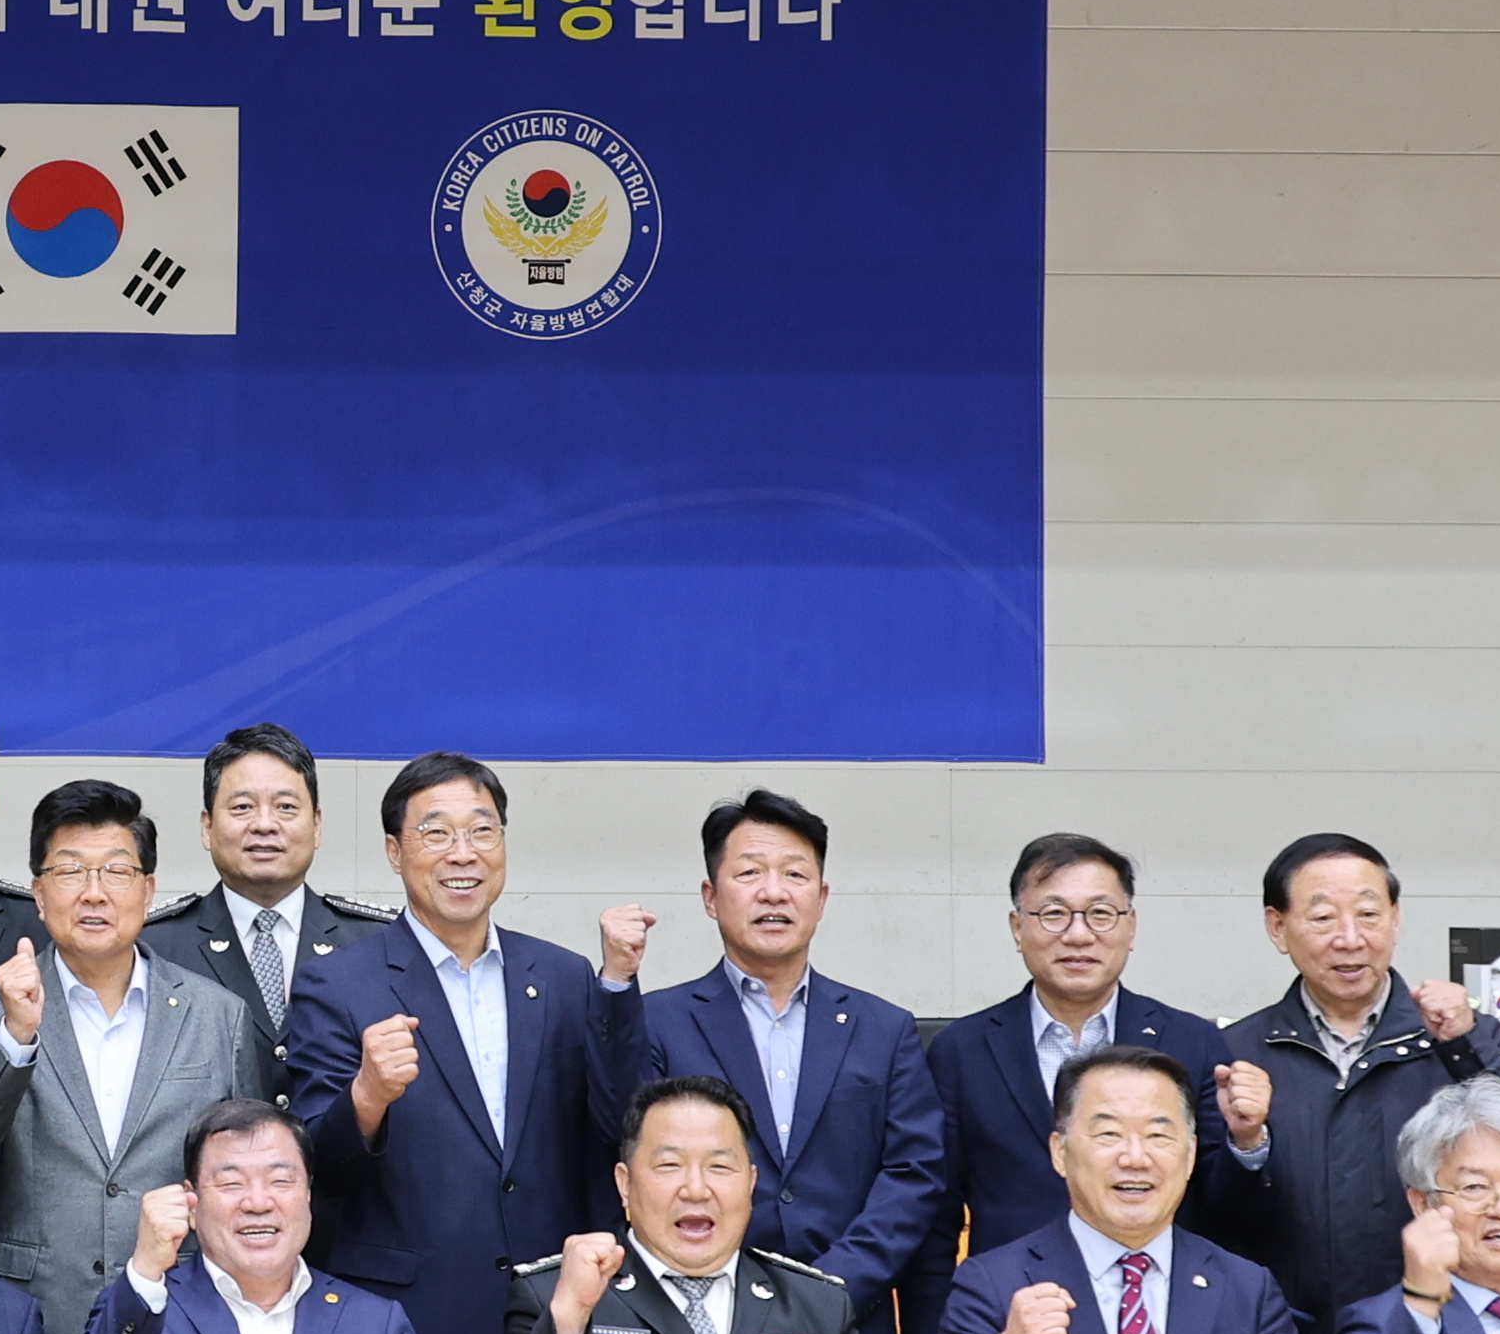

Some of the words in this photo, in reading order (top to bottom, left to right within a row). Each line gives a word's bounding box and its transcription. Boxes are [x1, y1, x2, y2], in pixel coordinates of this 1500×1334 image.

[442, 151, 484, 211] KOREA
[482, 117, 567, 153] CITIZENS
[575, 123, 603, 148] ON
[602, 141, 651, 211] PATROL
[456, 271, 503, 317] 산청군
[510, 274, 635, 331] 자율방범연합대
[529, 265, 563, 280] 자율방범
